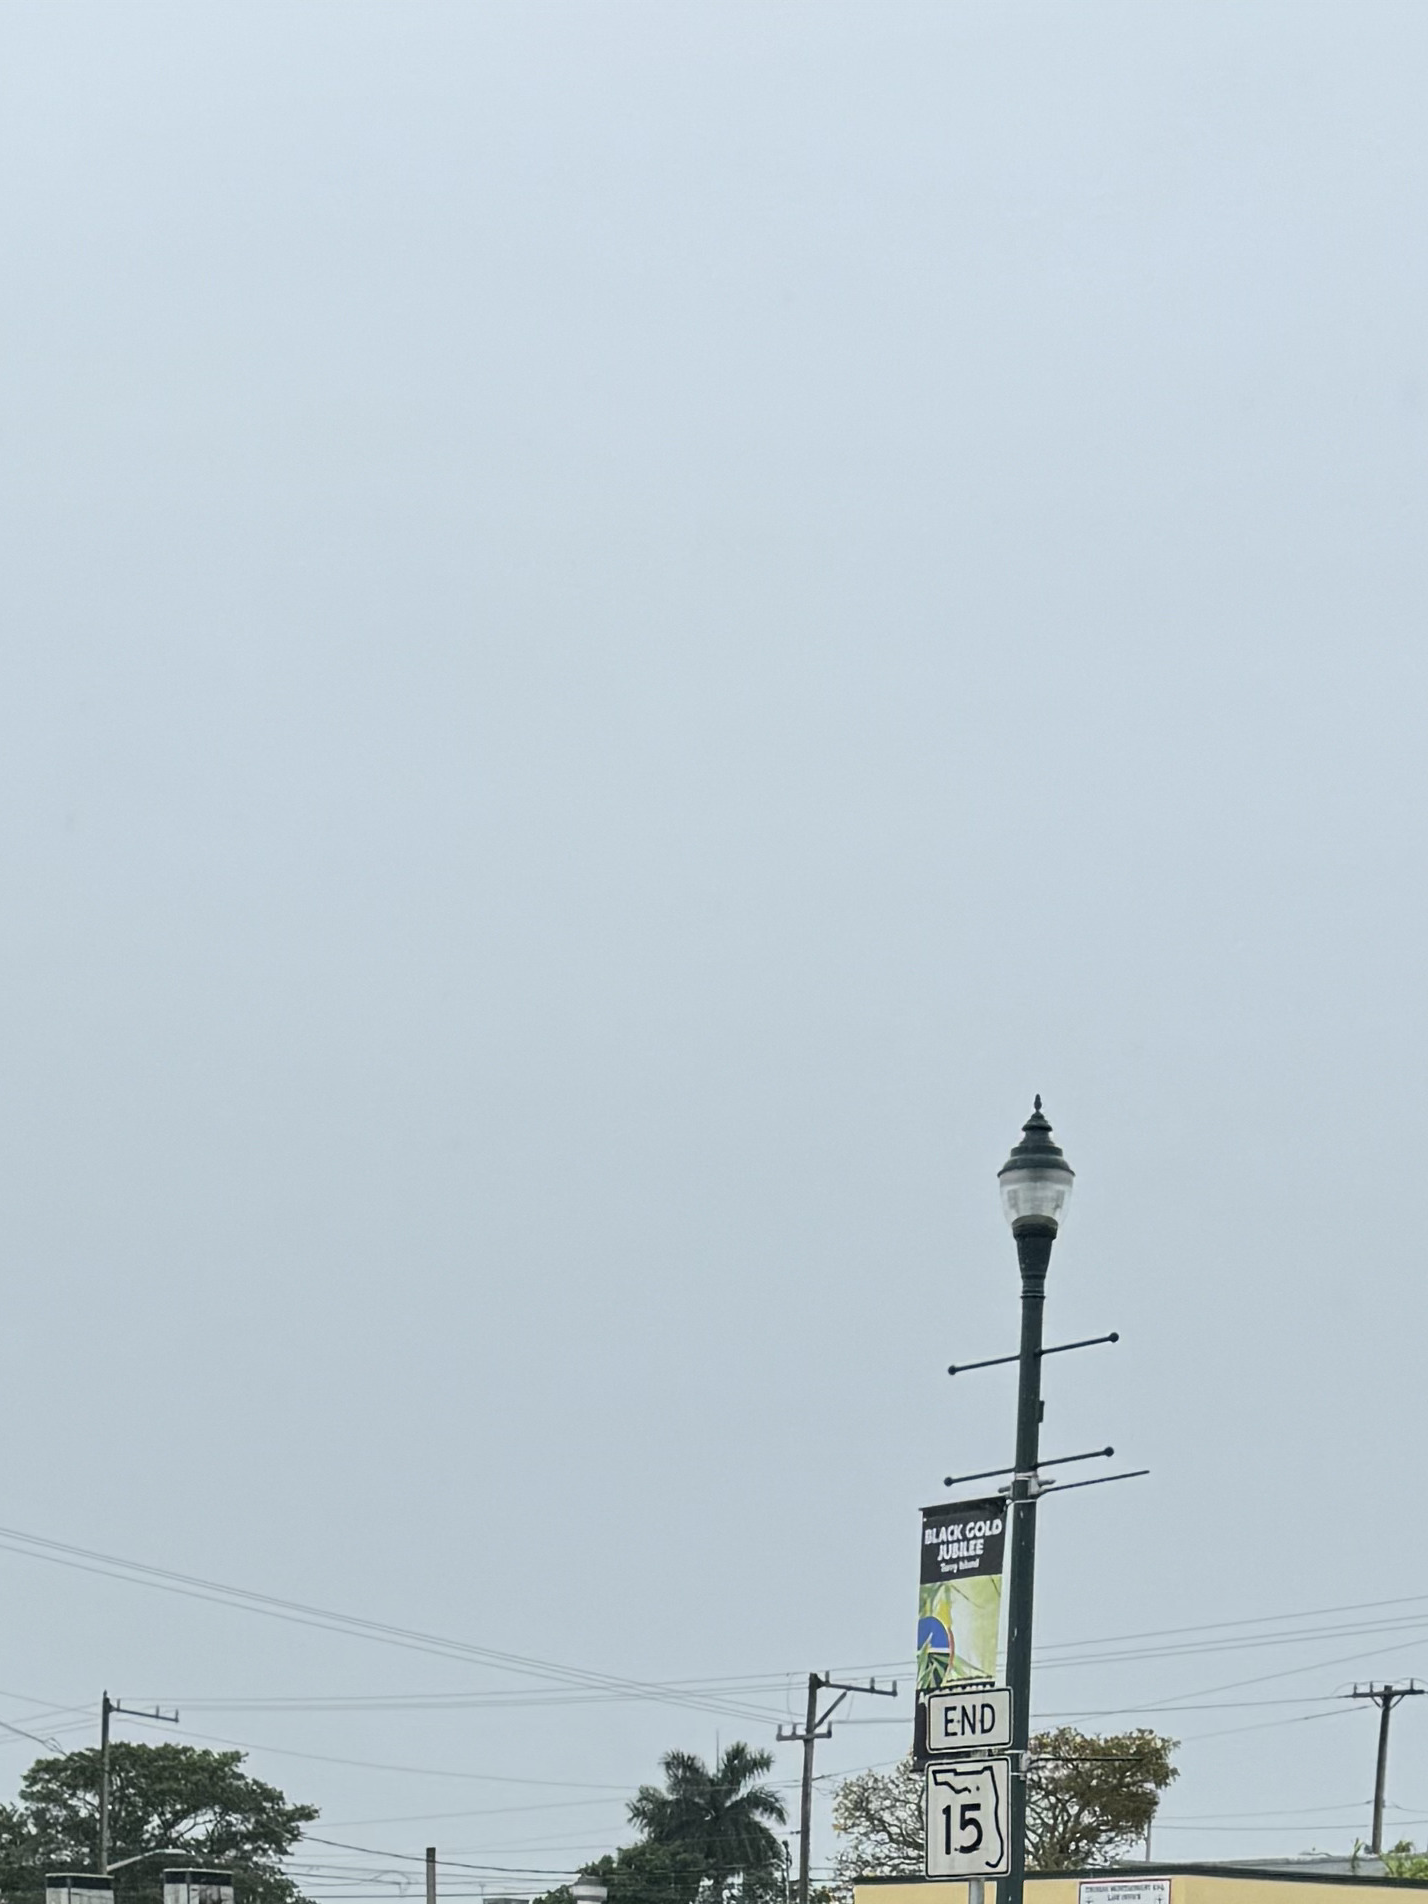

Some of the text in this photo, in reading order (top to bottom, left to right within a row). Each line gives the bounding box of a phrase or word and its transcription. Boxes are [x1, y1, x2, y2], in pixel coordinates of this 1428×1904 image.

[924, 1518, 1003, 1545] BLACK GOLD
[937, 1538, 985, 1561] JUBILEE
[943, 1702, 996, 1737] END
[941, 1803, 984, 1855] 15
